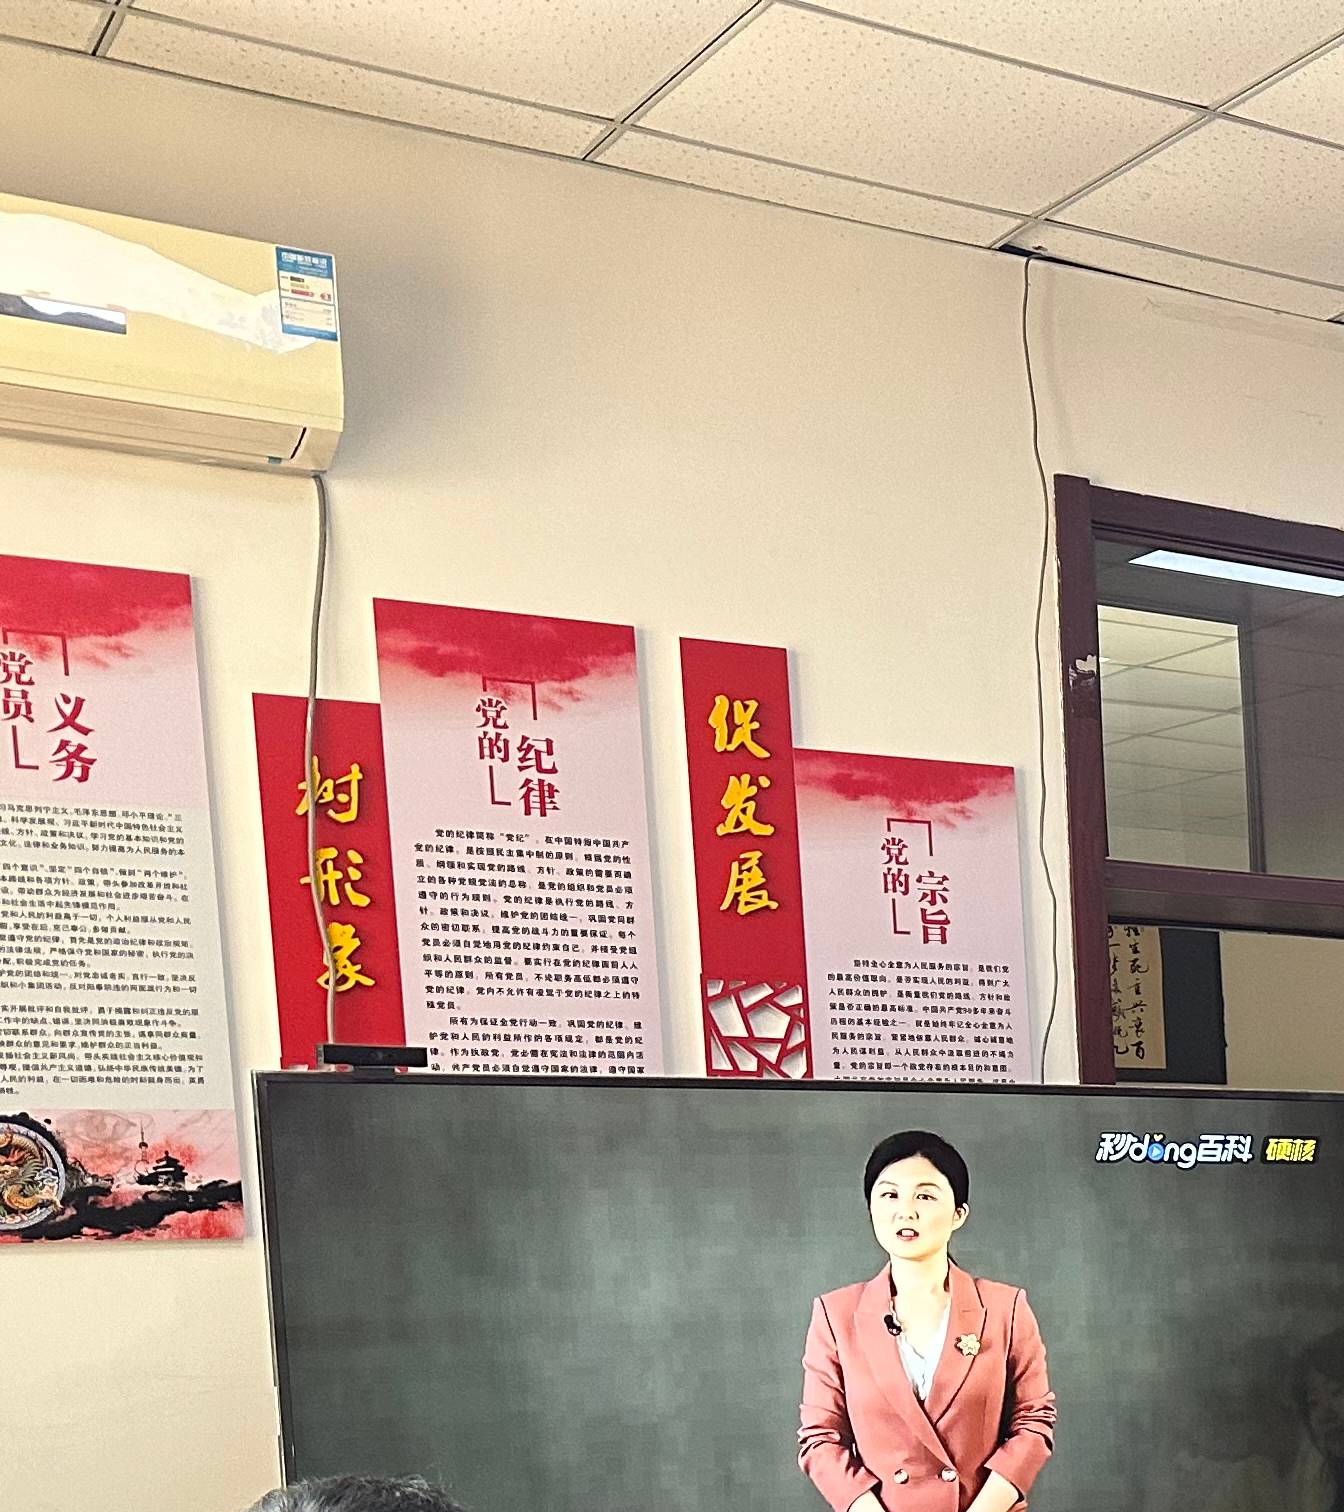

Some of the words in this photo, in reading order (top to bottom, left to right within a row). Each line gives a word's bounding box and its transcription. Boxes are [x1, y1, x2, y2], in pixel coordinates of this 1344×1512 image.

[0, 650, 35, 725] 党员
[46, 692, 97, 782] 义务
[475, 696, 511, 763] 党的
[516, 734, 561, 819] 纪律
[707, 693, 779, 917] 促发展
[295, 754, 376, 994] 树形象
[880, 835, 912, 897] 党的
[916, 868, 952, 946] 宗旨
[1266, 1137, 1317, 1162] 硬核
